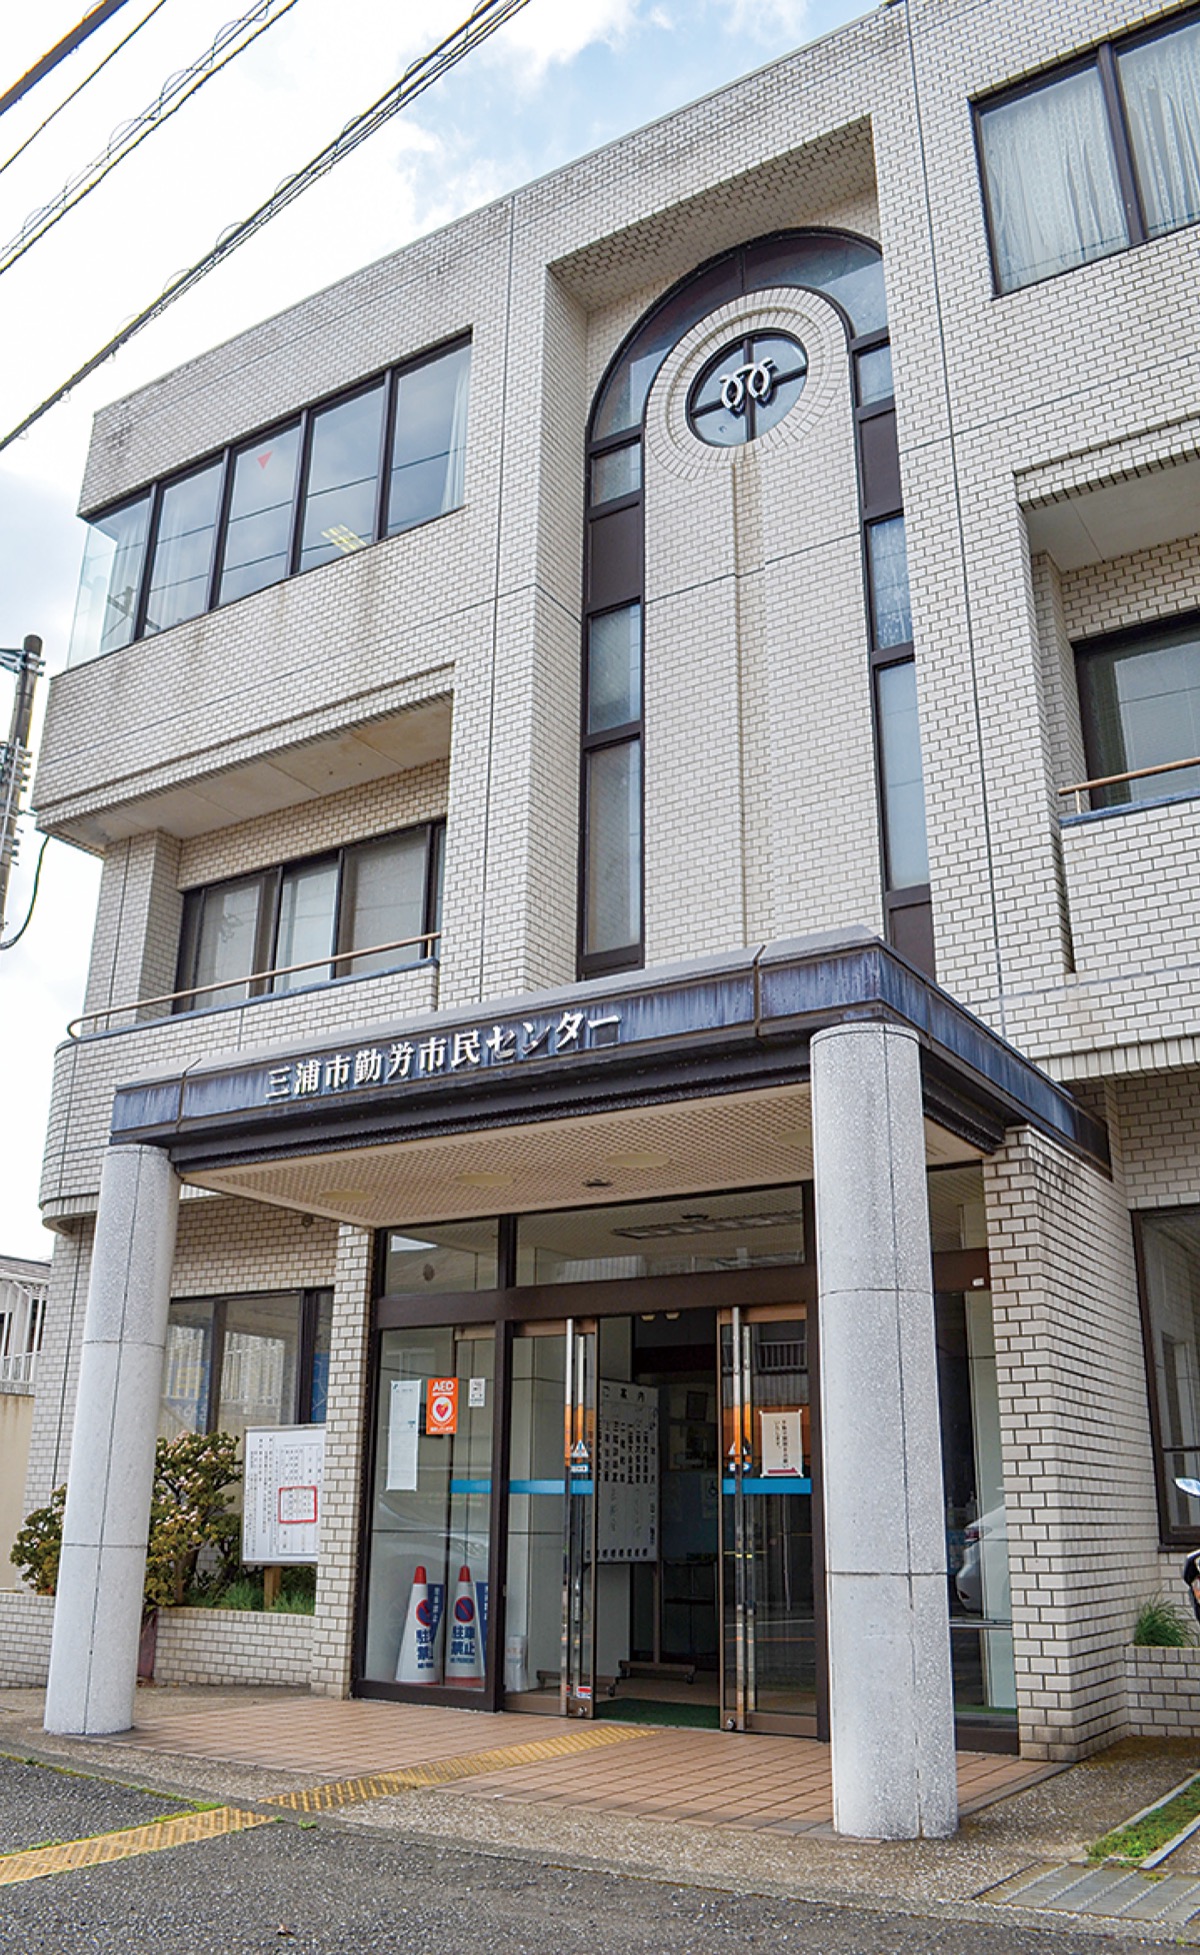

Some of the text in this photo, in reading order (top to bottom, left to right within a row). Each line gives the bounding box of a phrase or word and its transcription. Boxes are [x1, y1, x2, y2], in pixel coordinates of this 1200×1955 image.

[265, 1011, 621, 1099] 三浦市勤労市民センター
[432, 1380, 454, 1392] AED
[451, 1641, 476, 1656] 禁止
